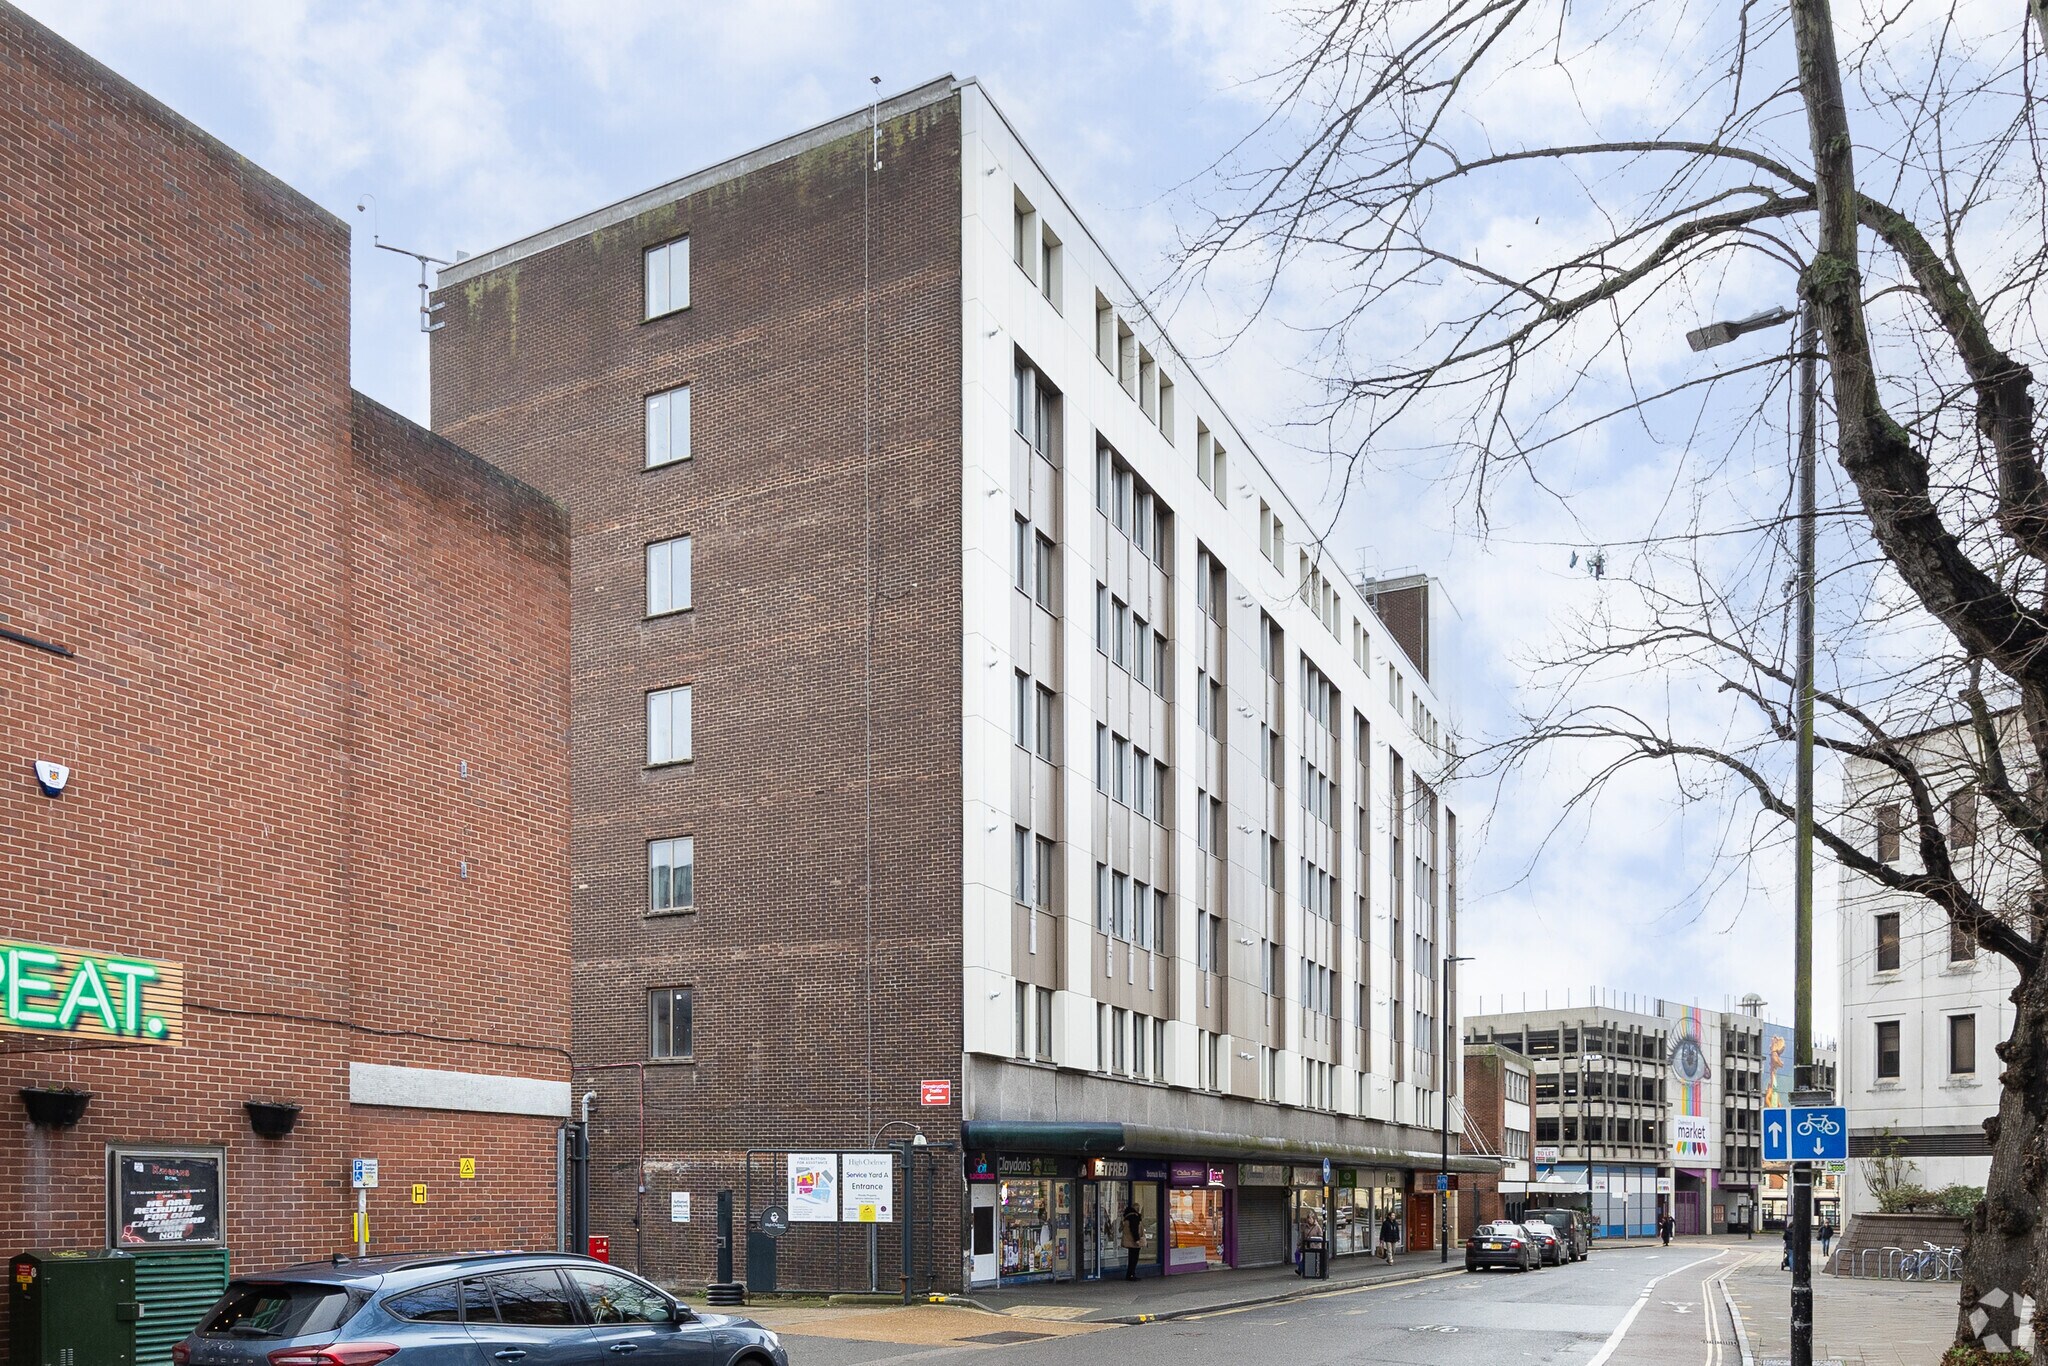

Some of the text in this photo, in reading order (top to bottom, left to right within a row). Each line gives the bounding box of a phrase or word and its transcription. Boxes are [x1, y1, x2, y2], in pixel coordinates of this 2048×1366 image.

[0, 949, 163, 1034] EAT.
[1677, 1121, 1706, 1139] market
[848, 1159, 862, 1167] High
[1094, 1160, 1128, 1177] BETFRED
[415, 1186, 425, 1201] H
[133, 1204, 204, 1214] RECRUITING
[170, 1211, 194, 1219] OUR
[131, 1217, 206, 1228] CHELMSFORD
[147, 1224, 187, 1233] VENUE
[159, 1232, 183, 1240] NOW
